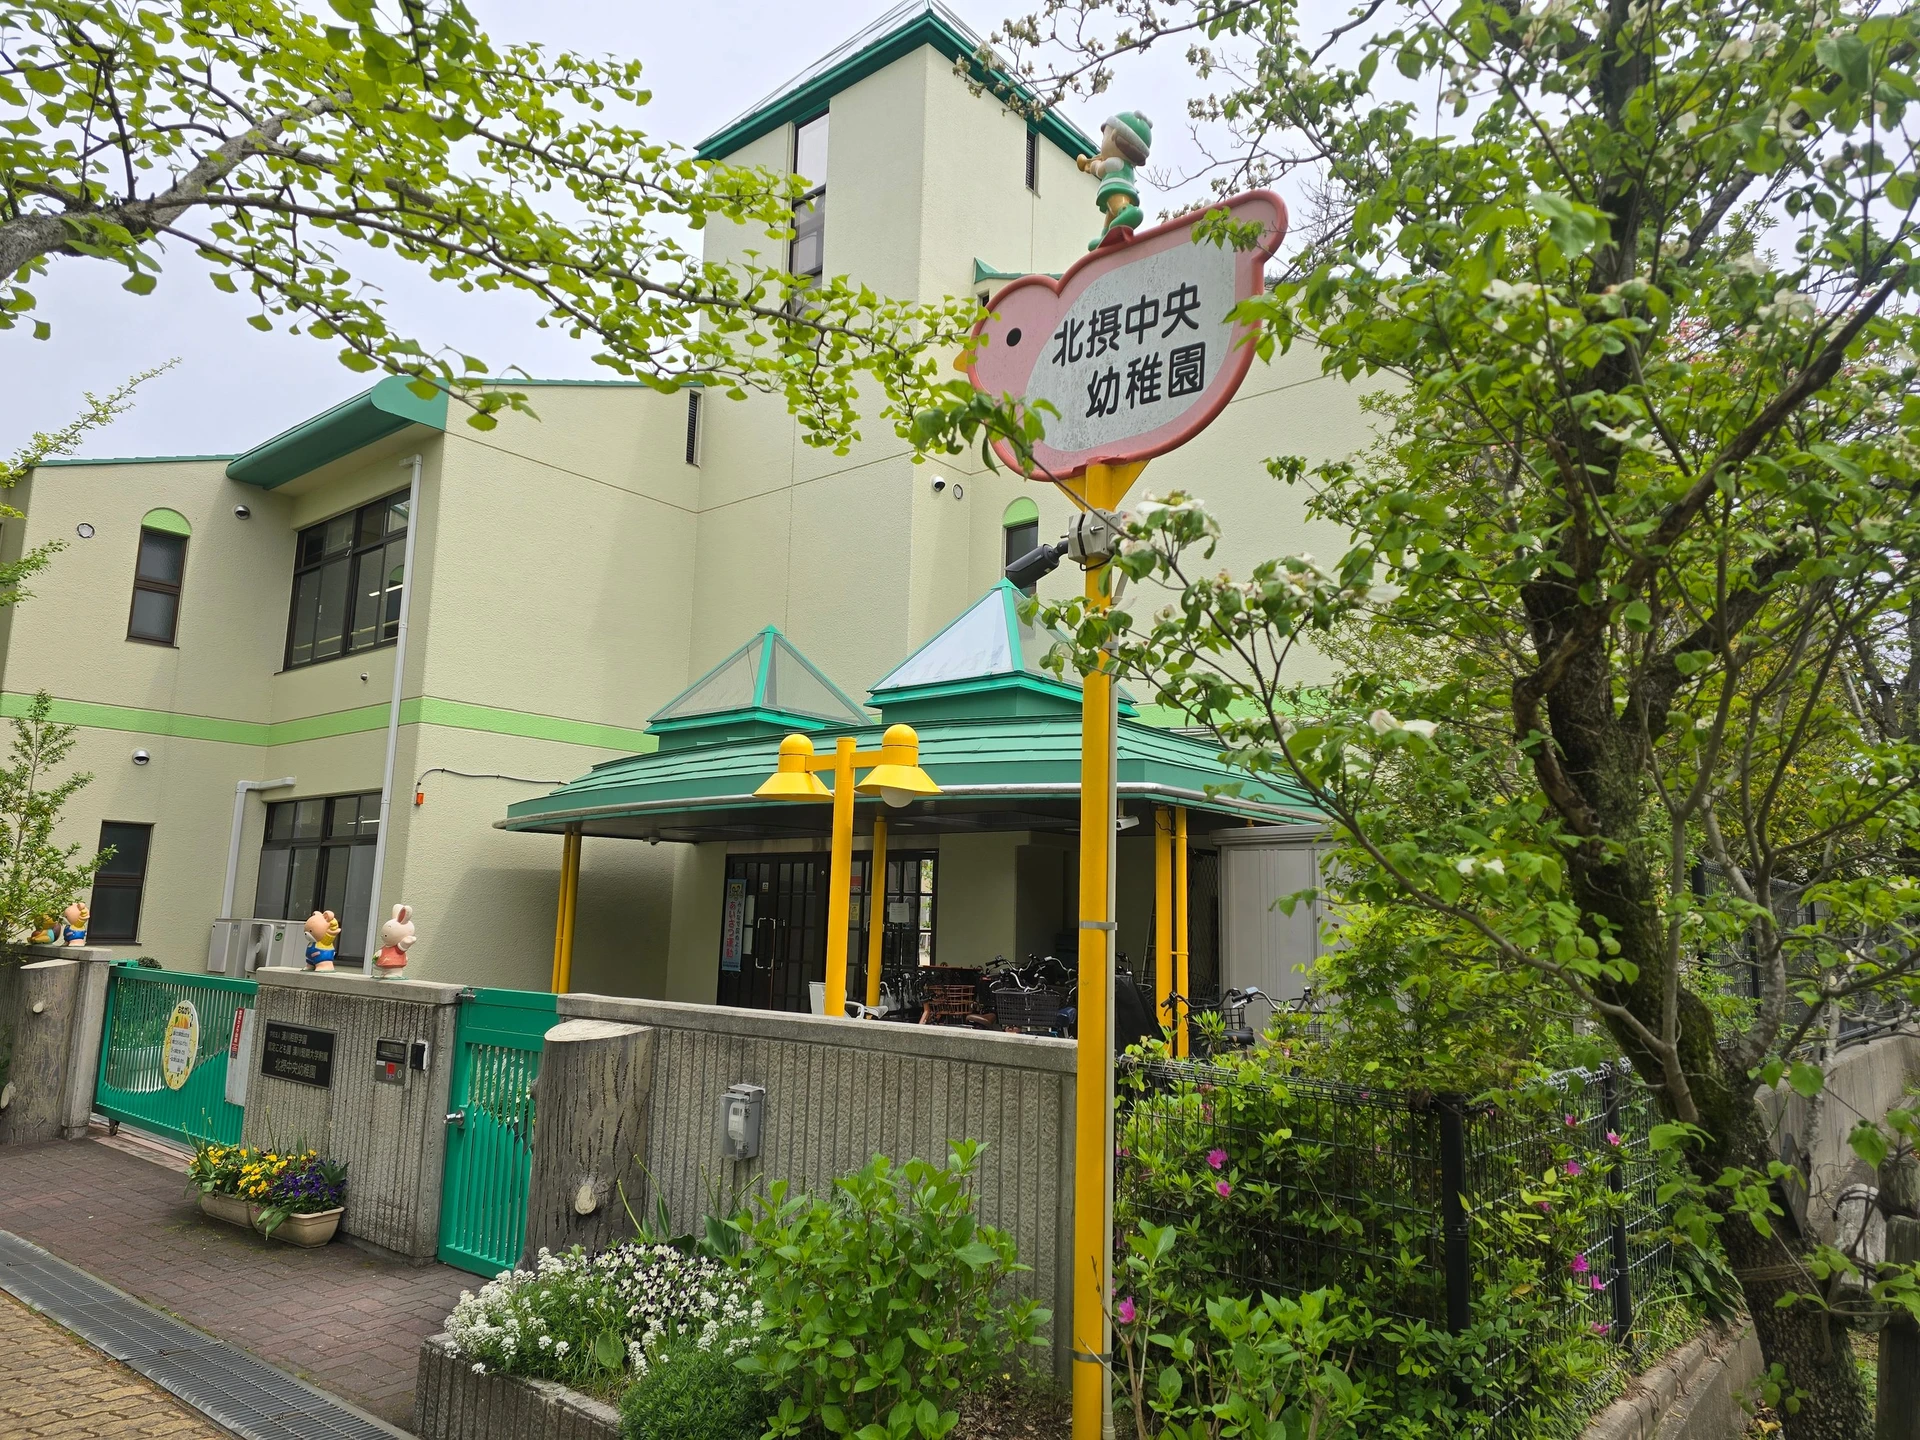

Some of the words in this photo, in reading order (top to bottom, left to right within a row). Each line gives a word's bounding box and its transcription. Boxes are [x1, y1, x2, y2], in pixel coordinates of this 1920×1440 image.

[1052, 282, 1201, 367] 北摂中央
[1085, 341, 1206, 418] 幼稚園
